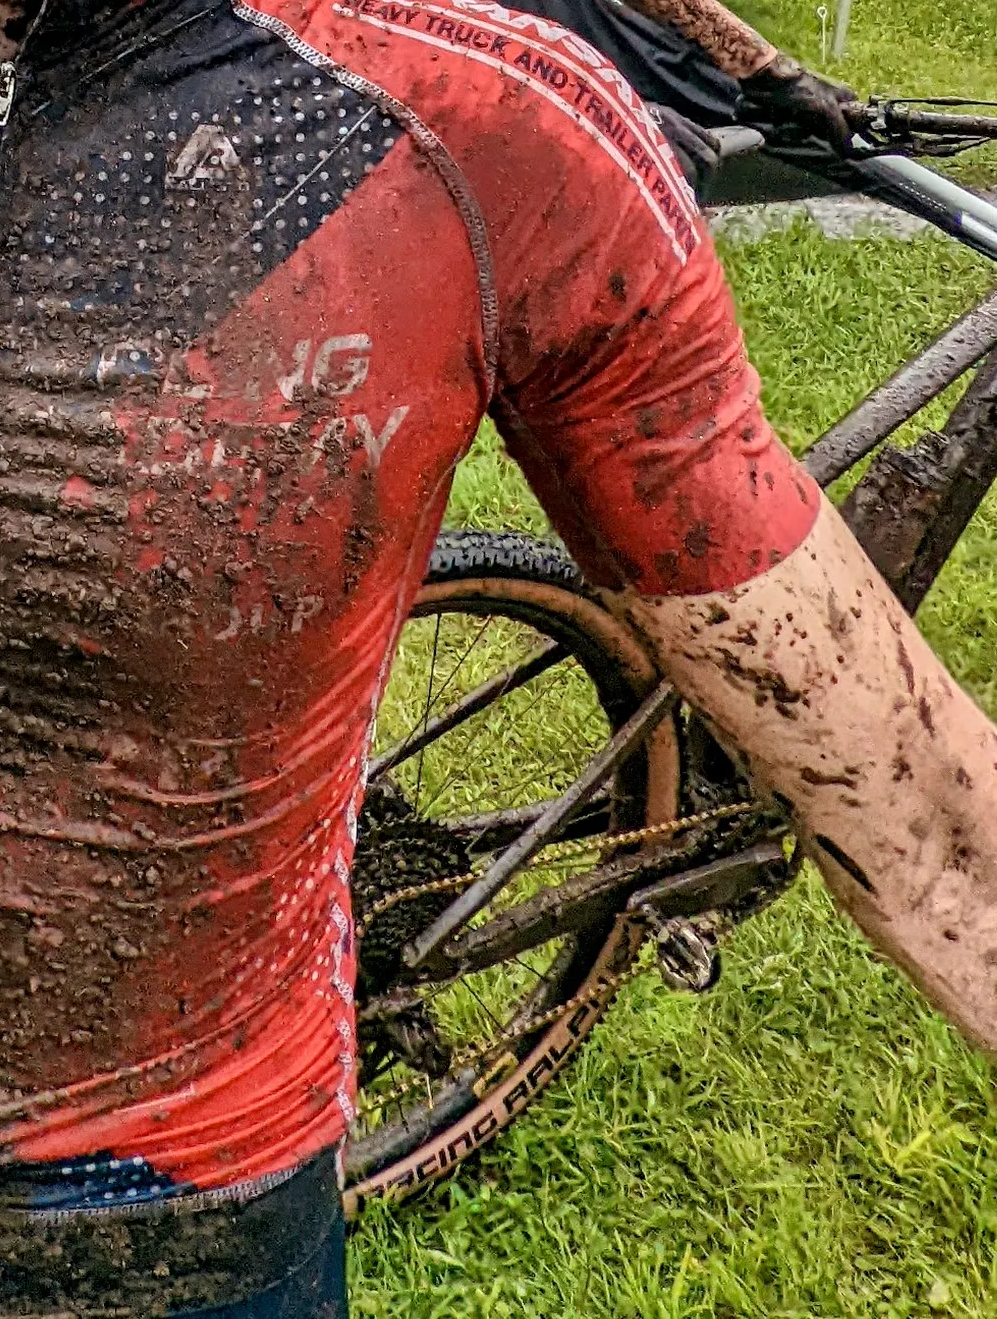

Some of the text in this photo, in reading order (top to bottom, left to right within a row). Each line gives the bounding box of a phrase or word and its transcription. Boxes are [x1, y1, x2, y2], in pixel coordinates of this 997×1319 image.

[426, 14, 512, 57] TRUCK
[514, 48, 569, 89] AND
[574, 80, 656, 179] TRAILER
